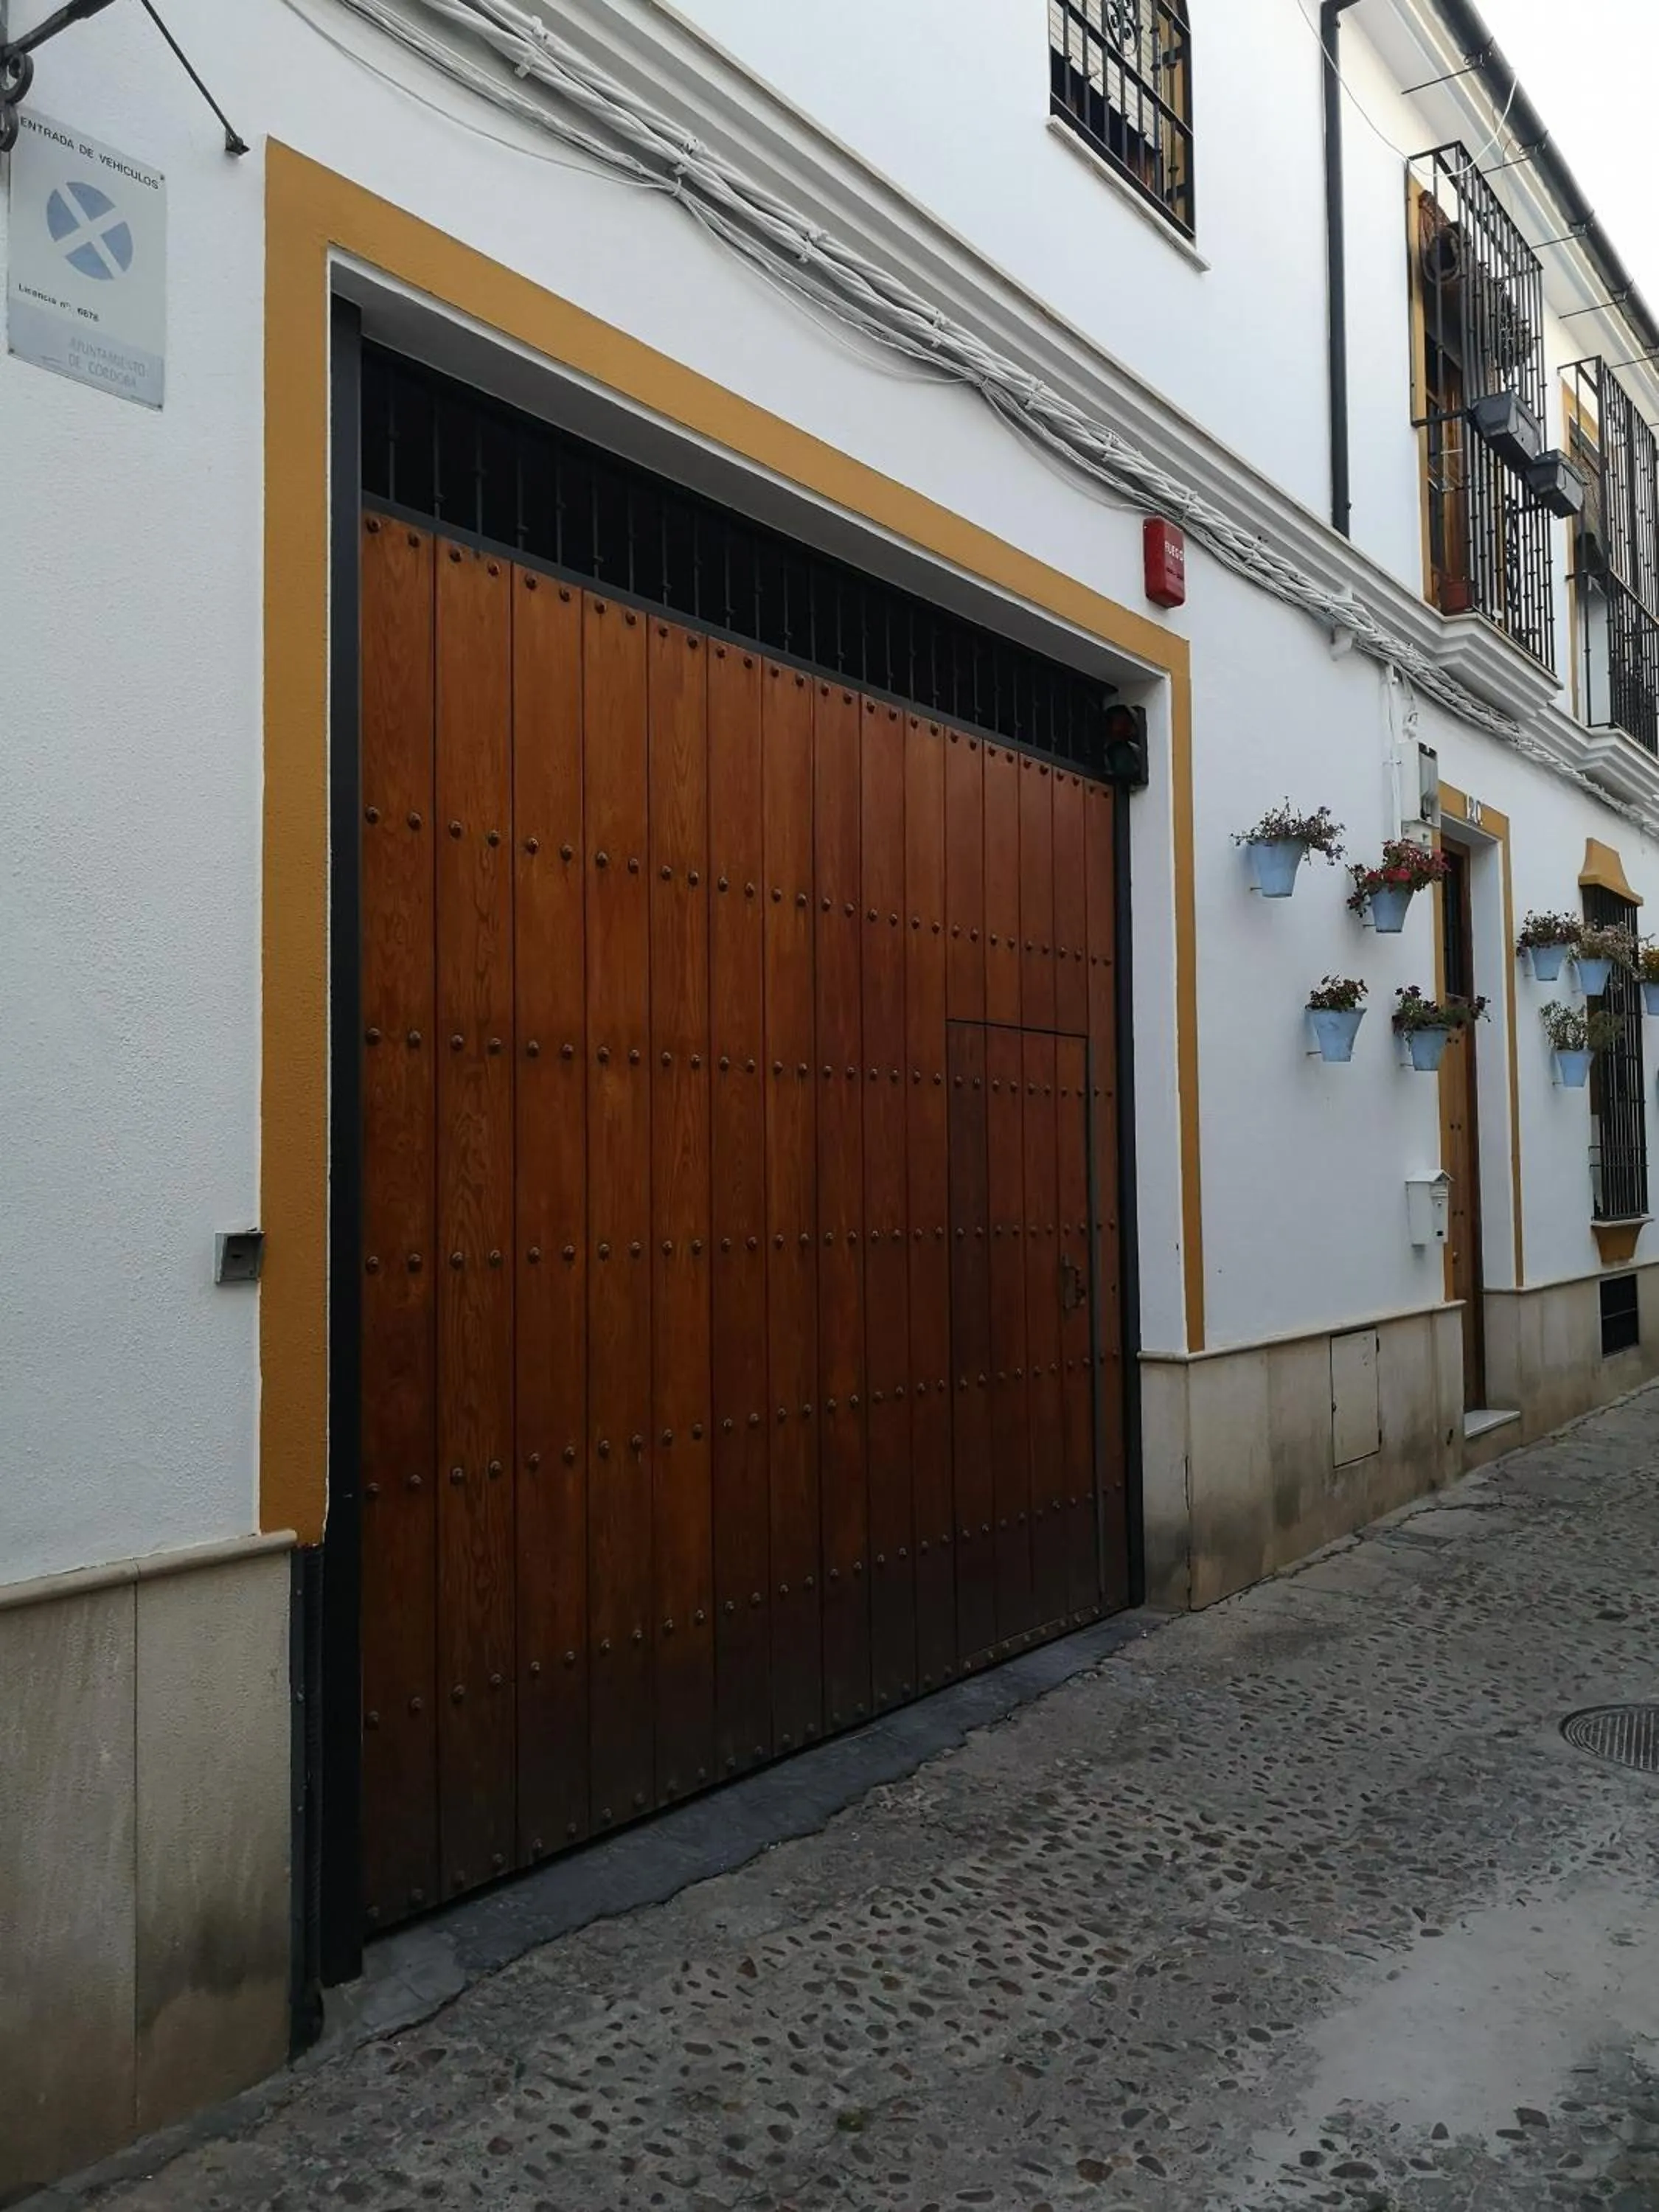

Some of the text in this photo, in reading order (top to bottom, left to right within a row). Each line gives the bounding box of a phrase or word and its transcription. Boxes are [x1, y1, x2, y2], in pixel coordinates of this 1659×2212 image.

[20, 116, 159, 189] ENTRADA DE VEHICULOS
[18, 282, 57, 305] Licencia
